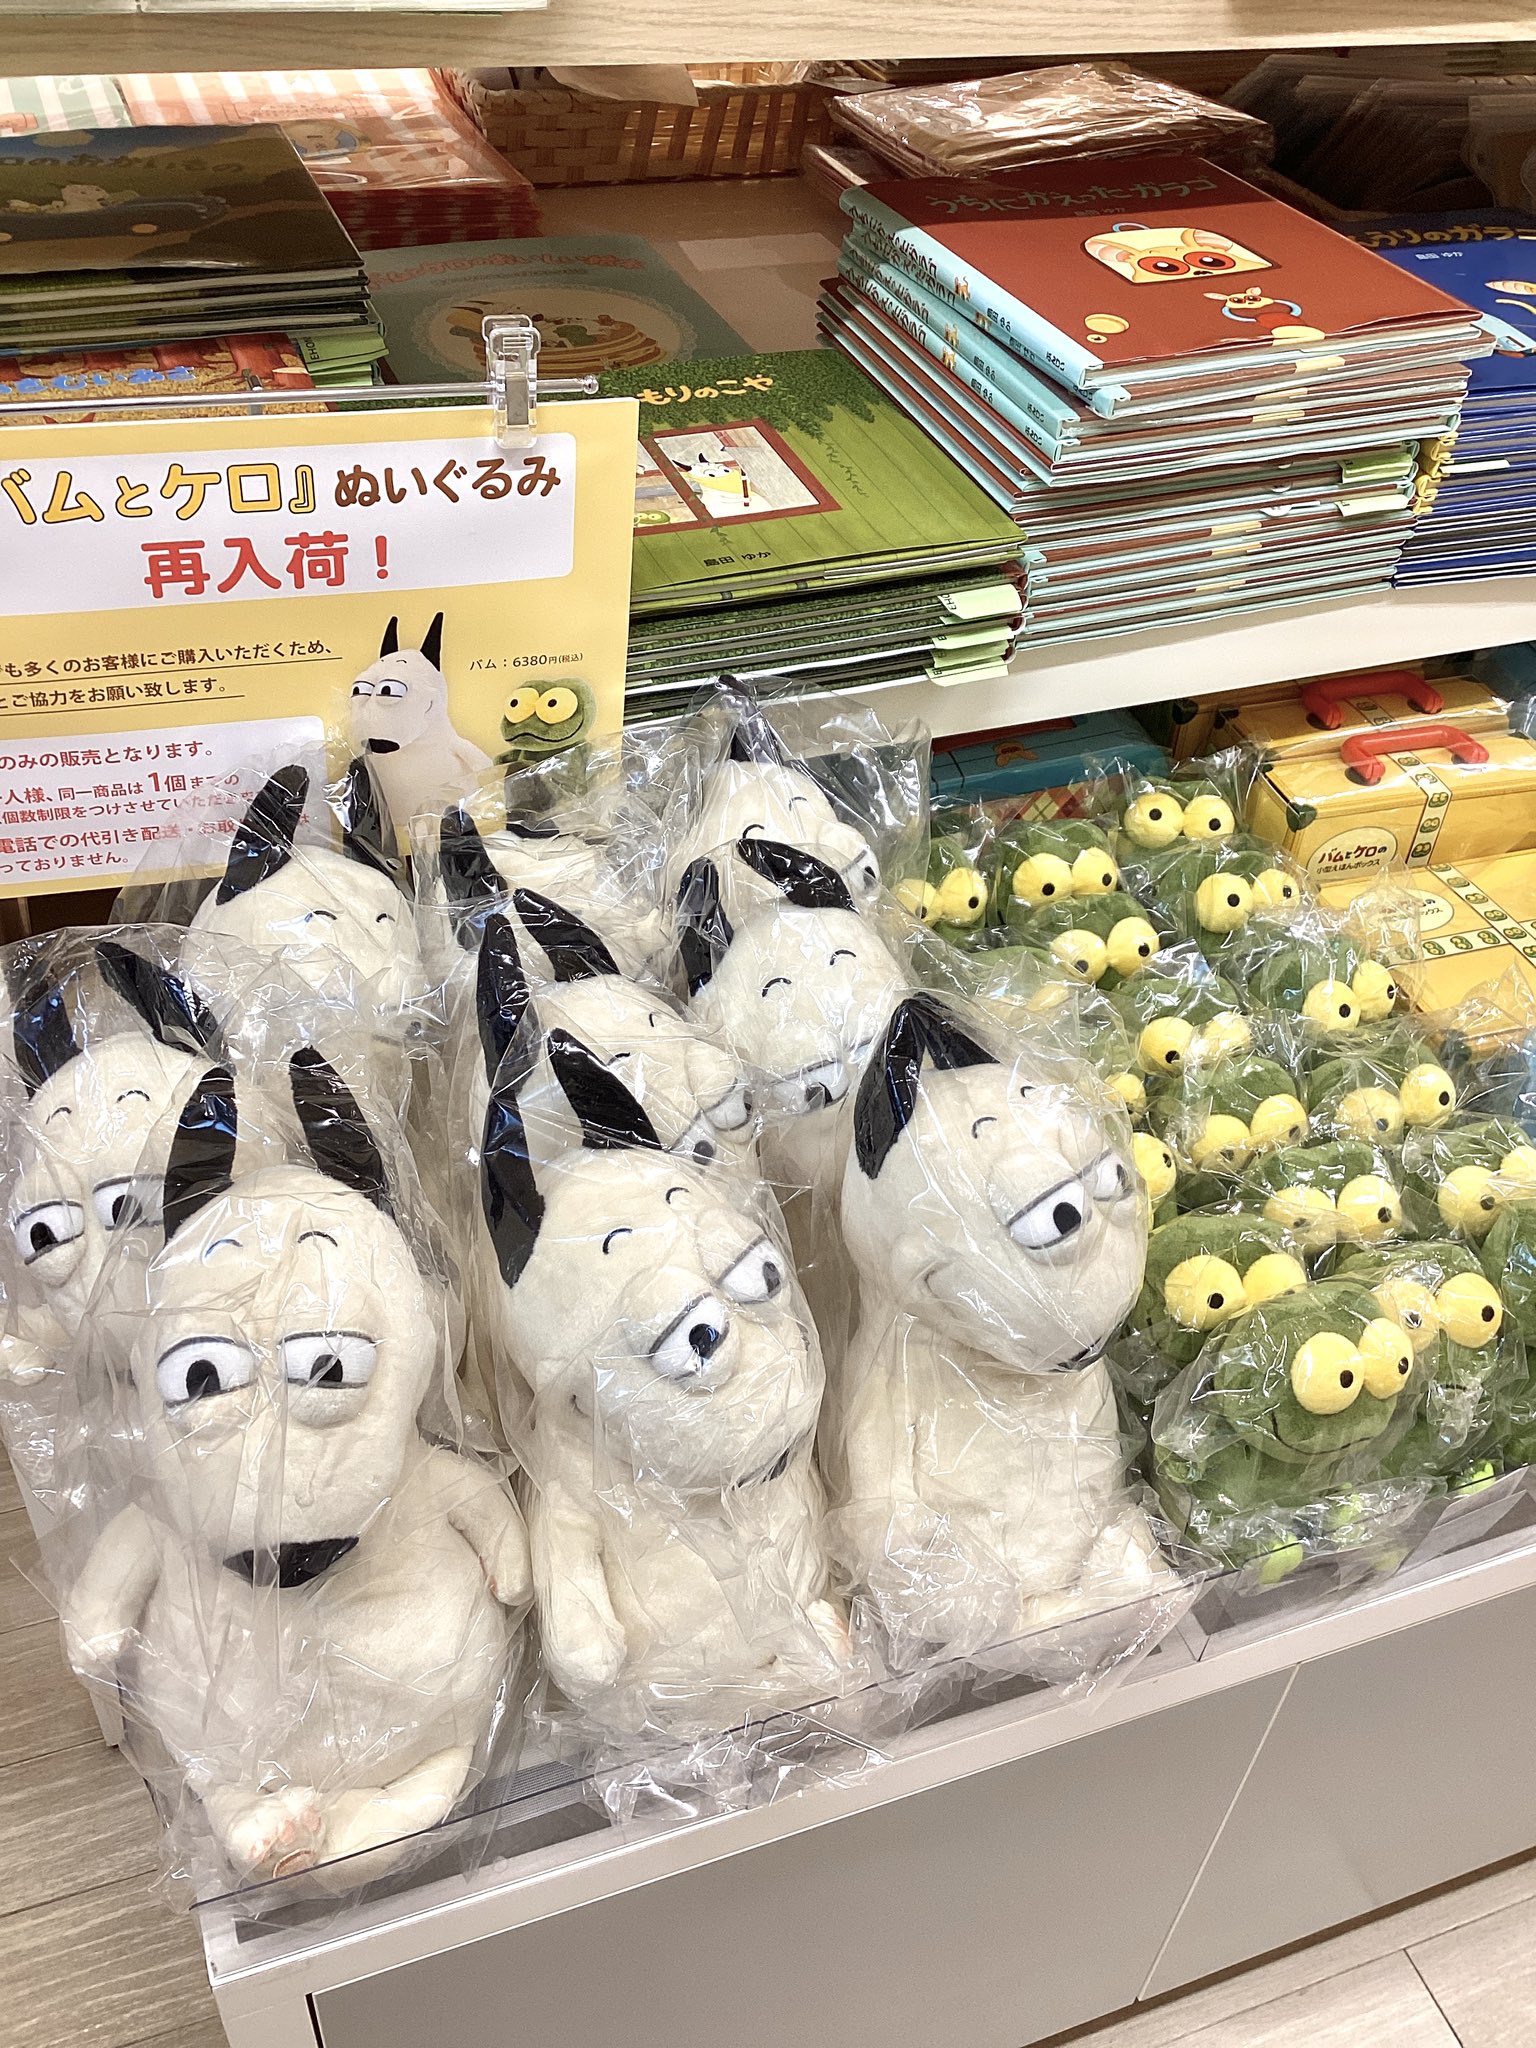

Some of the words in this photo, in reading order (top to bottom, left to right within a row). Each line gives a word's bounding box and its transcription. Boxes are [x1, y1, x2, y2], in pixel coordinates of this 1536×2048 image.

[926, 176, 1217, 214] うちにかえったガラゴ
[637, 373, 774, 406] もりのこや
[141, 531, 389, 599] 再入荷！
[703, 555, 735, 567] 島田
[741, 551, 772, 561] ゆか
[0, 640, 334, 678] も多くのお客様にご購入いただくため、
[0, 740, 214, 770] のみの販売となります。
[1318, 844, 1388, 864] バムとケロの
